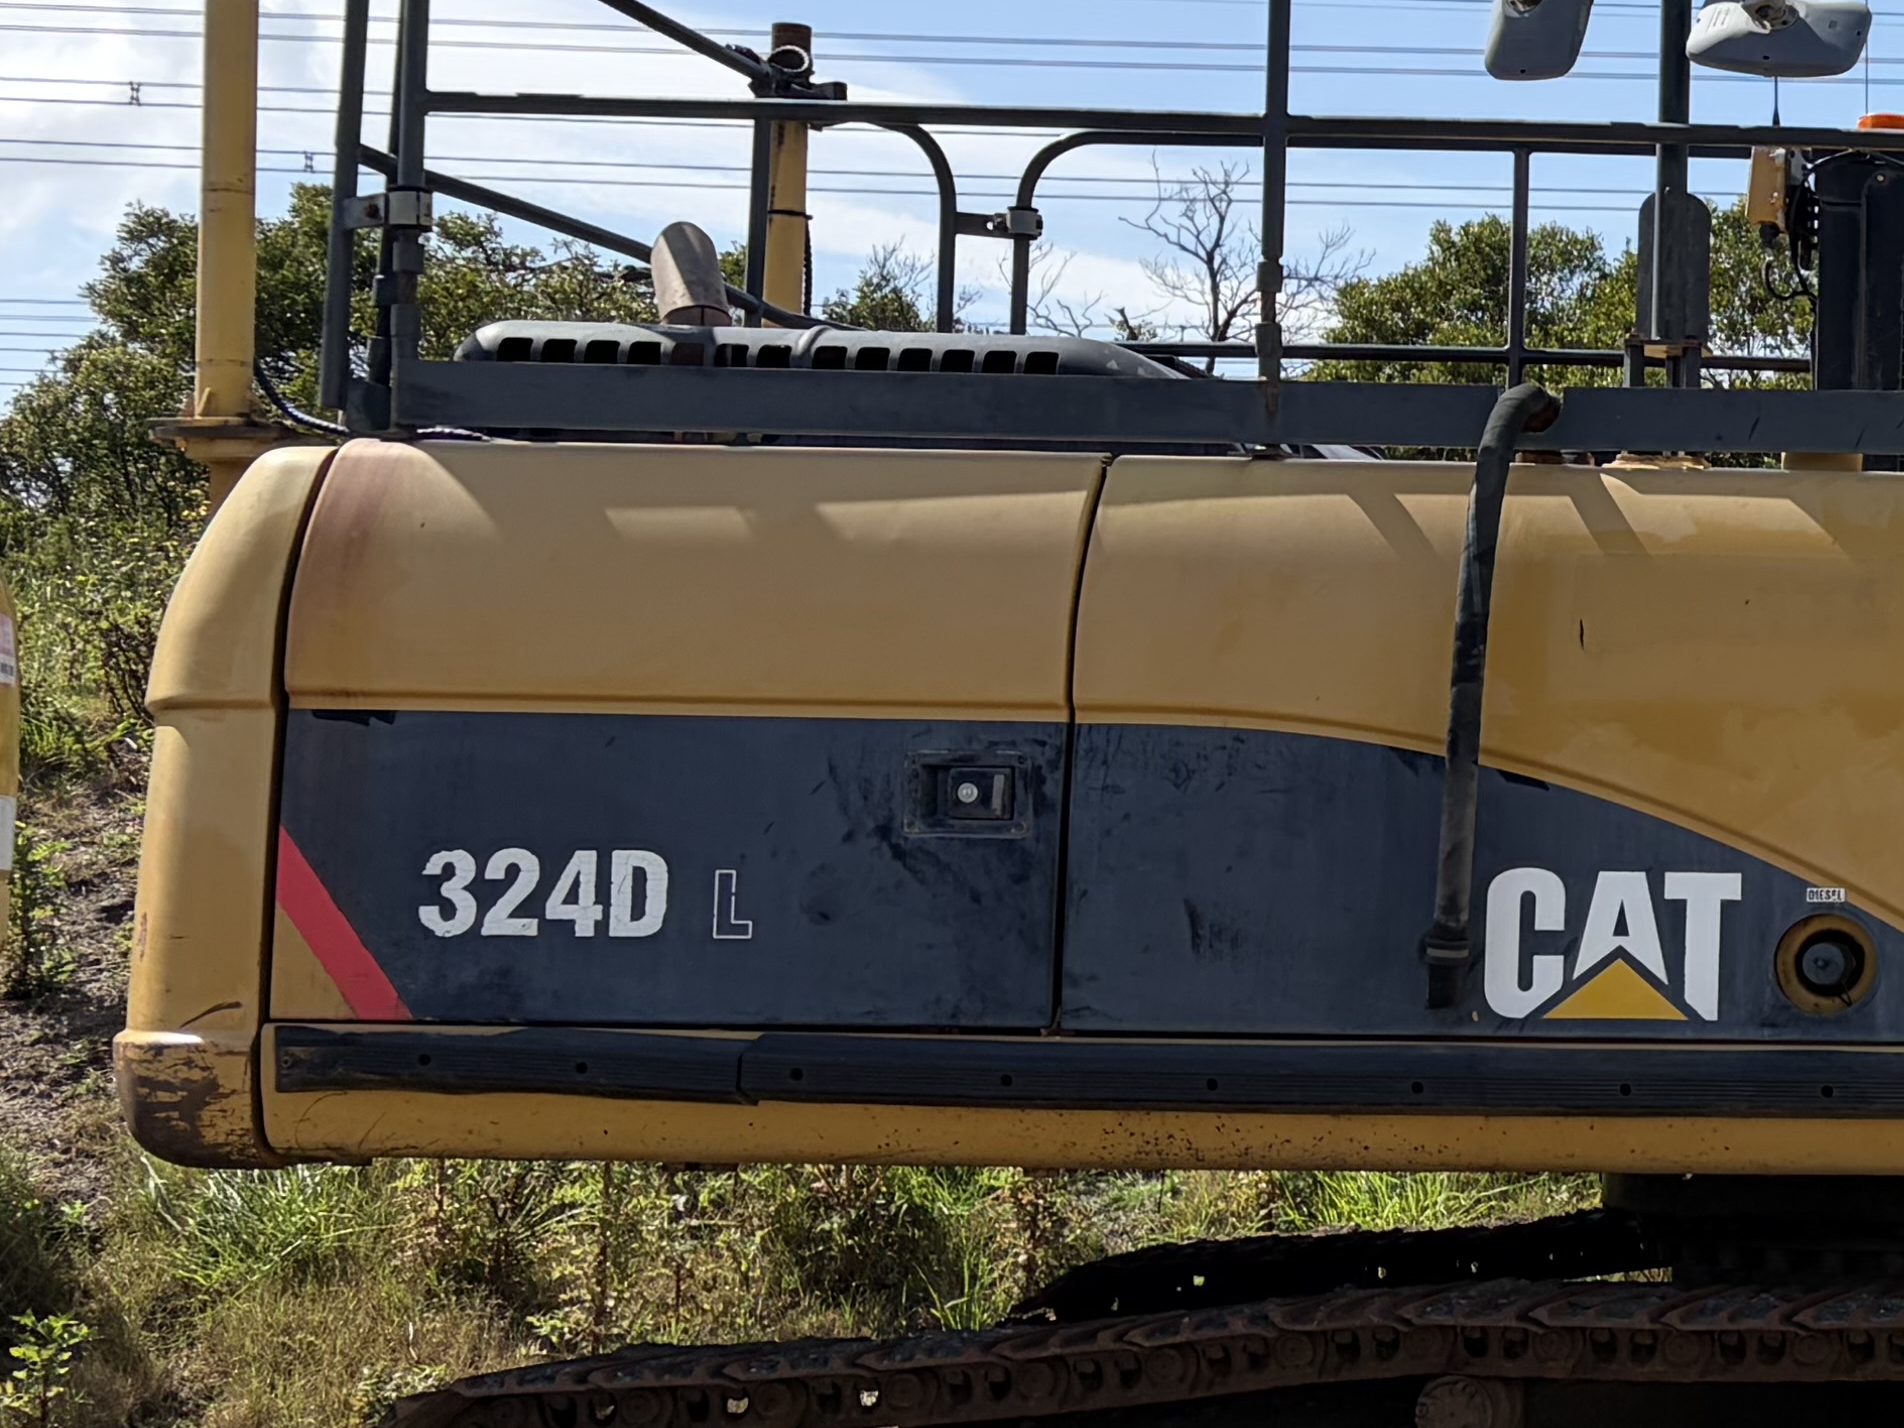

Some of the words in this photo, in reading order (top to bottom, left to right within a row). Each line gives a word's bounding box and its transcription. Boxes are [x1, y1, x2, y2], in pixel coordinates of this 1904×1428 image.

[418, 847, 669, 939] 324D
[712, 868, 753, 940] L
[1483, 866, 1742, 1021] CAT
